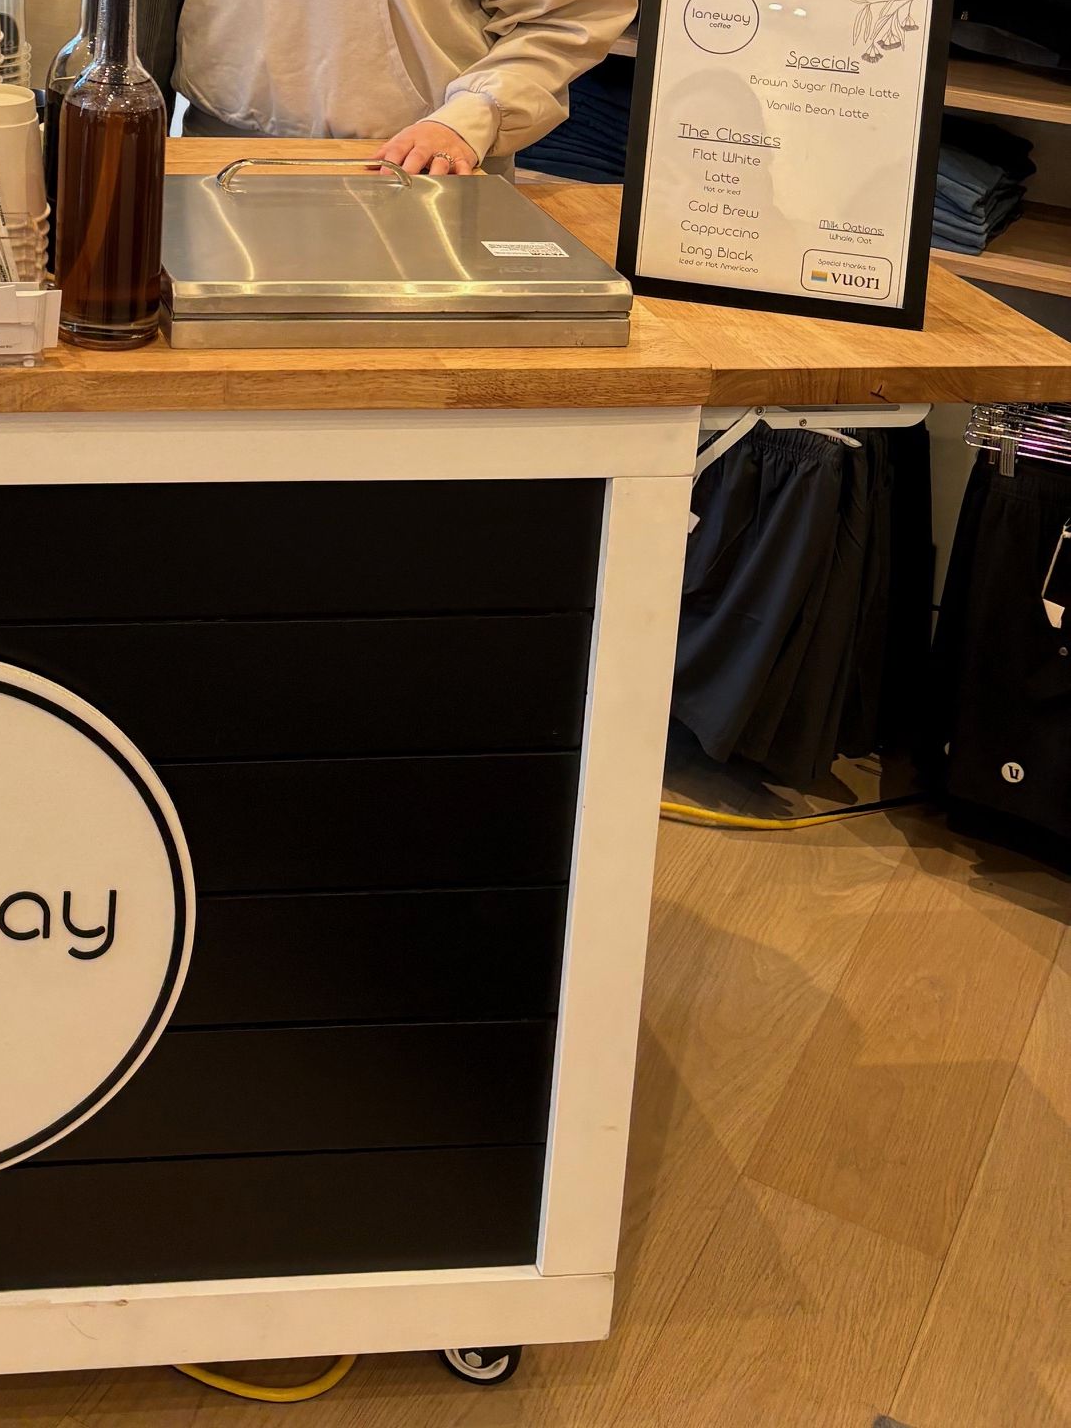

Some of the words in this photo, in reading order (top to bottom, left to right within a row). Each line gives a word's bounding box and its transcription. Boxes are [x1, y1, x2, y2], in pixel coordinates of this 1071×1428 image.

[692, 8, 751, 26] laneway
[709, 22, 732, 30] coffee
[786, 50, 860, 73] Specials
[749, 74, 788, 88] Brown
[791, 79, 827, 93] Sugar
[829, 83, 866, 97] Maple
[869, 87, 900, 100] Latte
[766, 99, 802, 113] Vanilla
[805, 103, 835, 116] Bean
[839, 107, 870, 120] Latte
[679, 122, 710, 139] The
[716, 127, 782, 147] Classics
[692, 147, 718, 162] Flat
[722, 151, 762, 166] White
[704, 170, 740, 185] Latte
[703, 185, 716, 193] Hot
[726, 187, 741, 196] Iced
[688, 200, 719, 214] Cold
[722, 204, 760, 219] Brew
[680, 219, 760, 240] Cappuccino
[819, 219, 839, 230] Milk
[856, 236, 872, 244] Oat
[680, 242, 713, 259] Long
[717, 246, 754, 262] Black
[679, 258, 694, 266] Iced
[705, 261, 719, 269] Hot
[719, 263, 759, 274] Americano
[817, 258, 841, 268] Special
[842, 262, 867, 271] thanks
[831, 272, 880, 290] vuori
